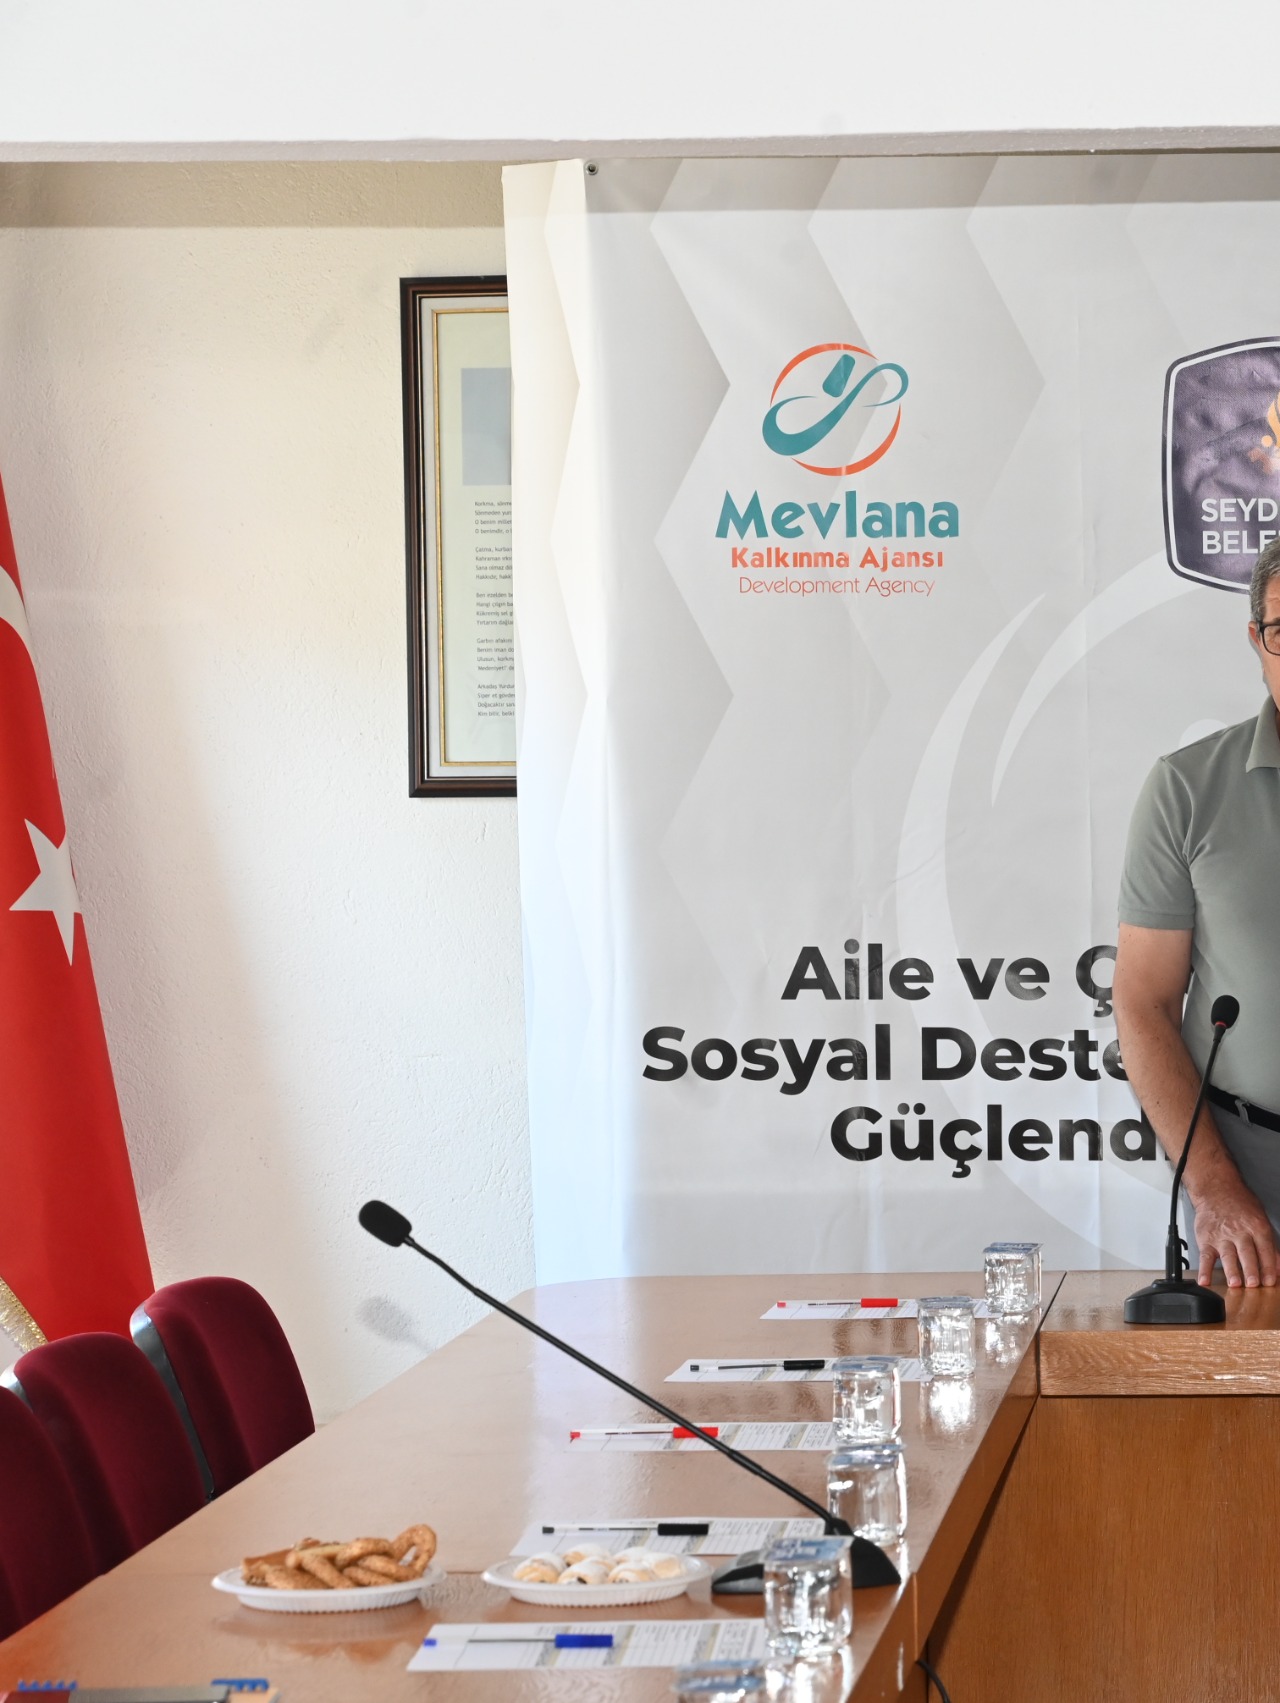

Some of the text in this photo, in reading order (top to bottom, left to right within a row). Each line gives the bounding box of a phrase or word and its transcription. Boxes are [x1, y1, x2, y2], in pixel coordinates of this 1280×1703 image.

[714, 489, 960, 541] Mevlana
[731, 546, 944, 573] Kalkınma Ajansı
[739, 576, 936, 598] Development Agency
[780, 938, 935, 1001] Aile
[956, 957, 1051, 1001] ve
[641, 1023, 1130, 1096] Sosyal Deste
[829, 1102, 1171, 1179] Güçlend
